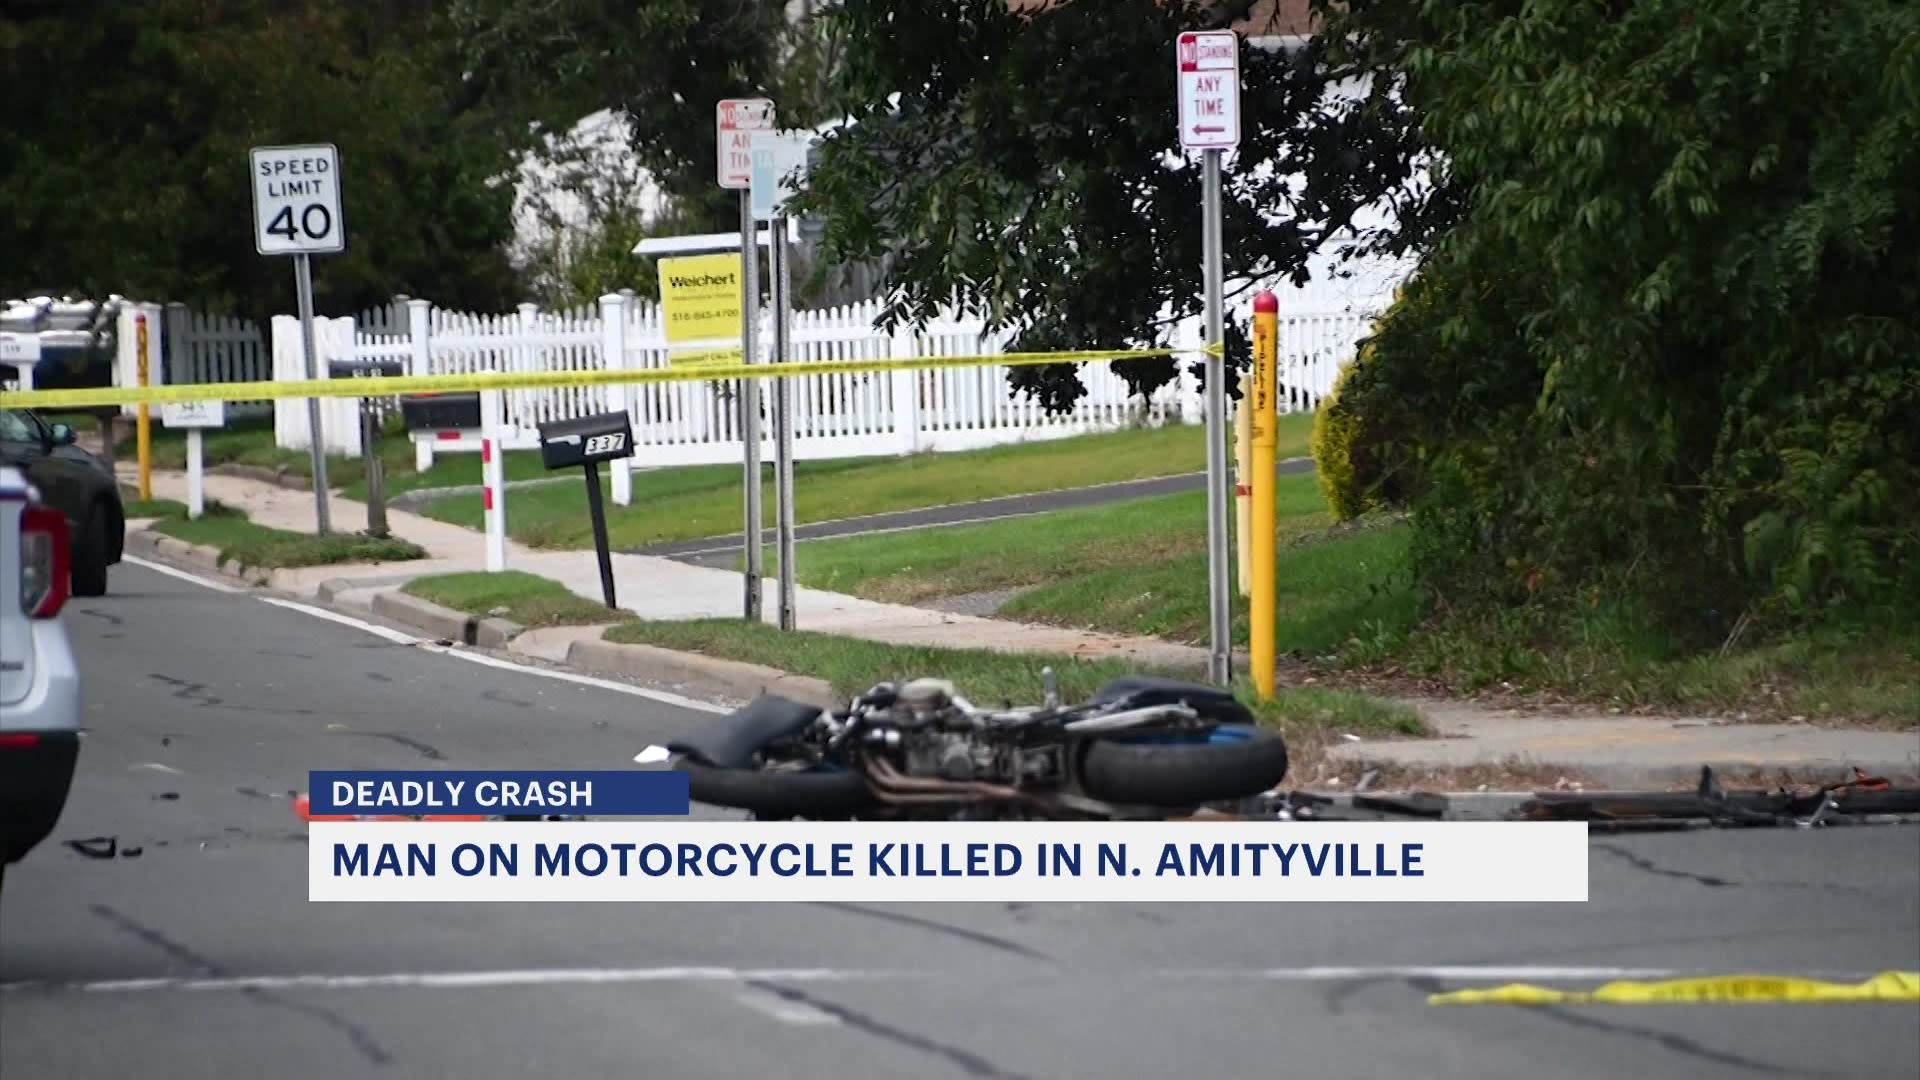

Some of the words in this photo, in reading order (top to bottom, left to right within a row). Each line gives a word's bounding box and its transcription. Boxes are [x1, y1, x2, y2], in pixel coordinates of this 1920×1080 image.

[1182, 42, 1196, 63] NO
[1196, 77, 1220, 92] ANY
[1194, 98, 1224, 116] TIME
[732, 133, 751, 149] AN
[260, 158, 329, 176] SPEED
[268, 180, 322, 197] LIMIT
[266, 203, 331, 241] 40
[668, 273, 736, 288] Weichert
[588, 434, 623, 452] 337
